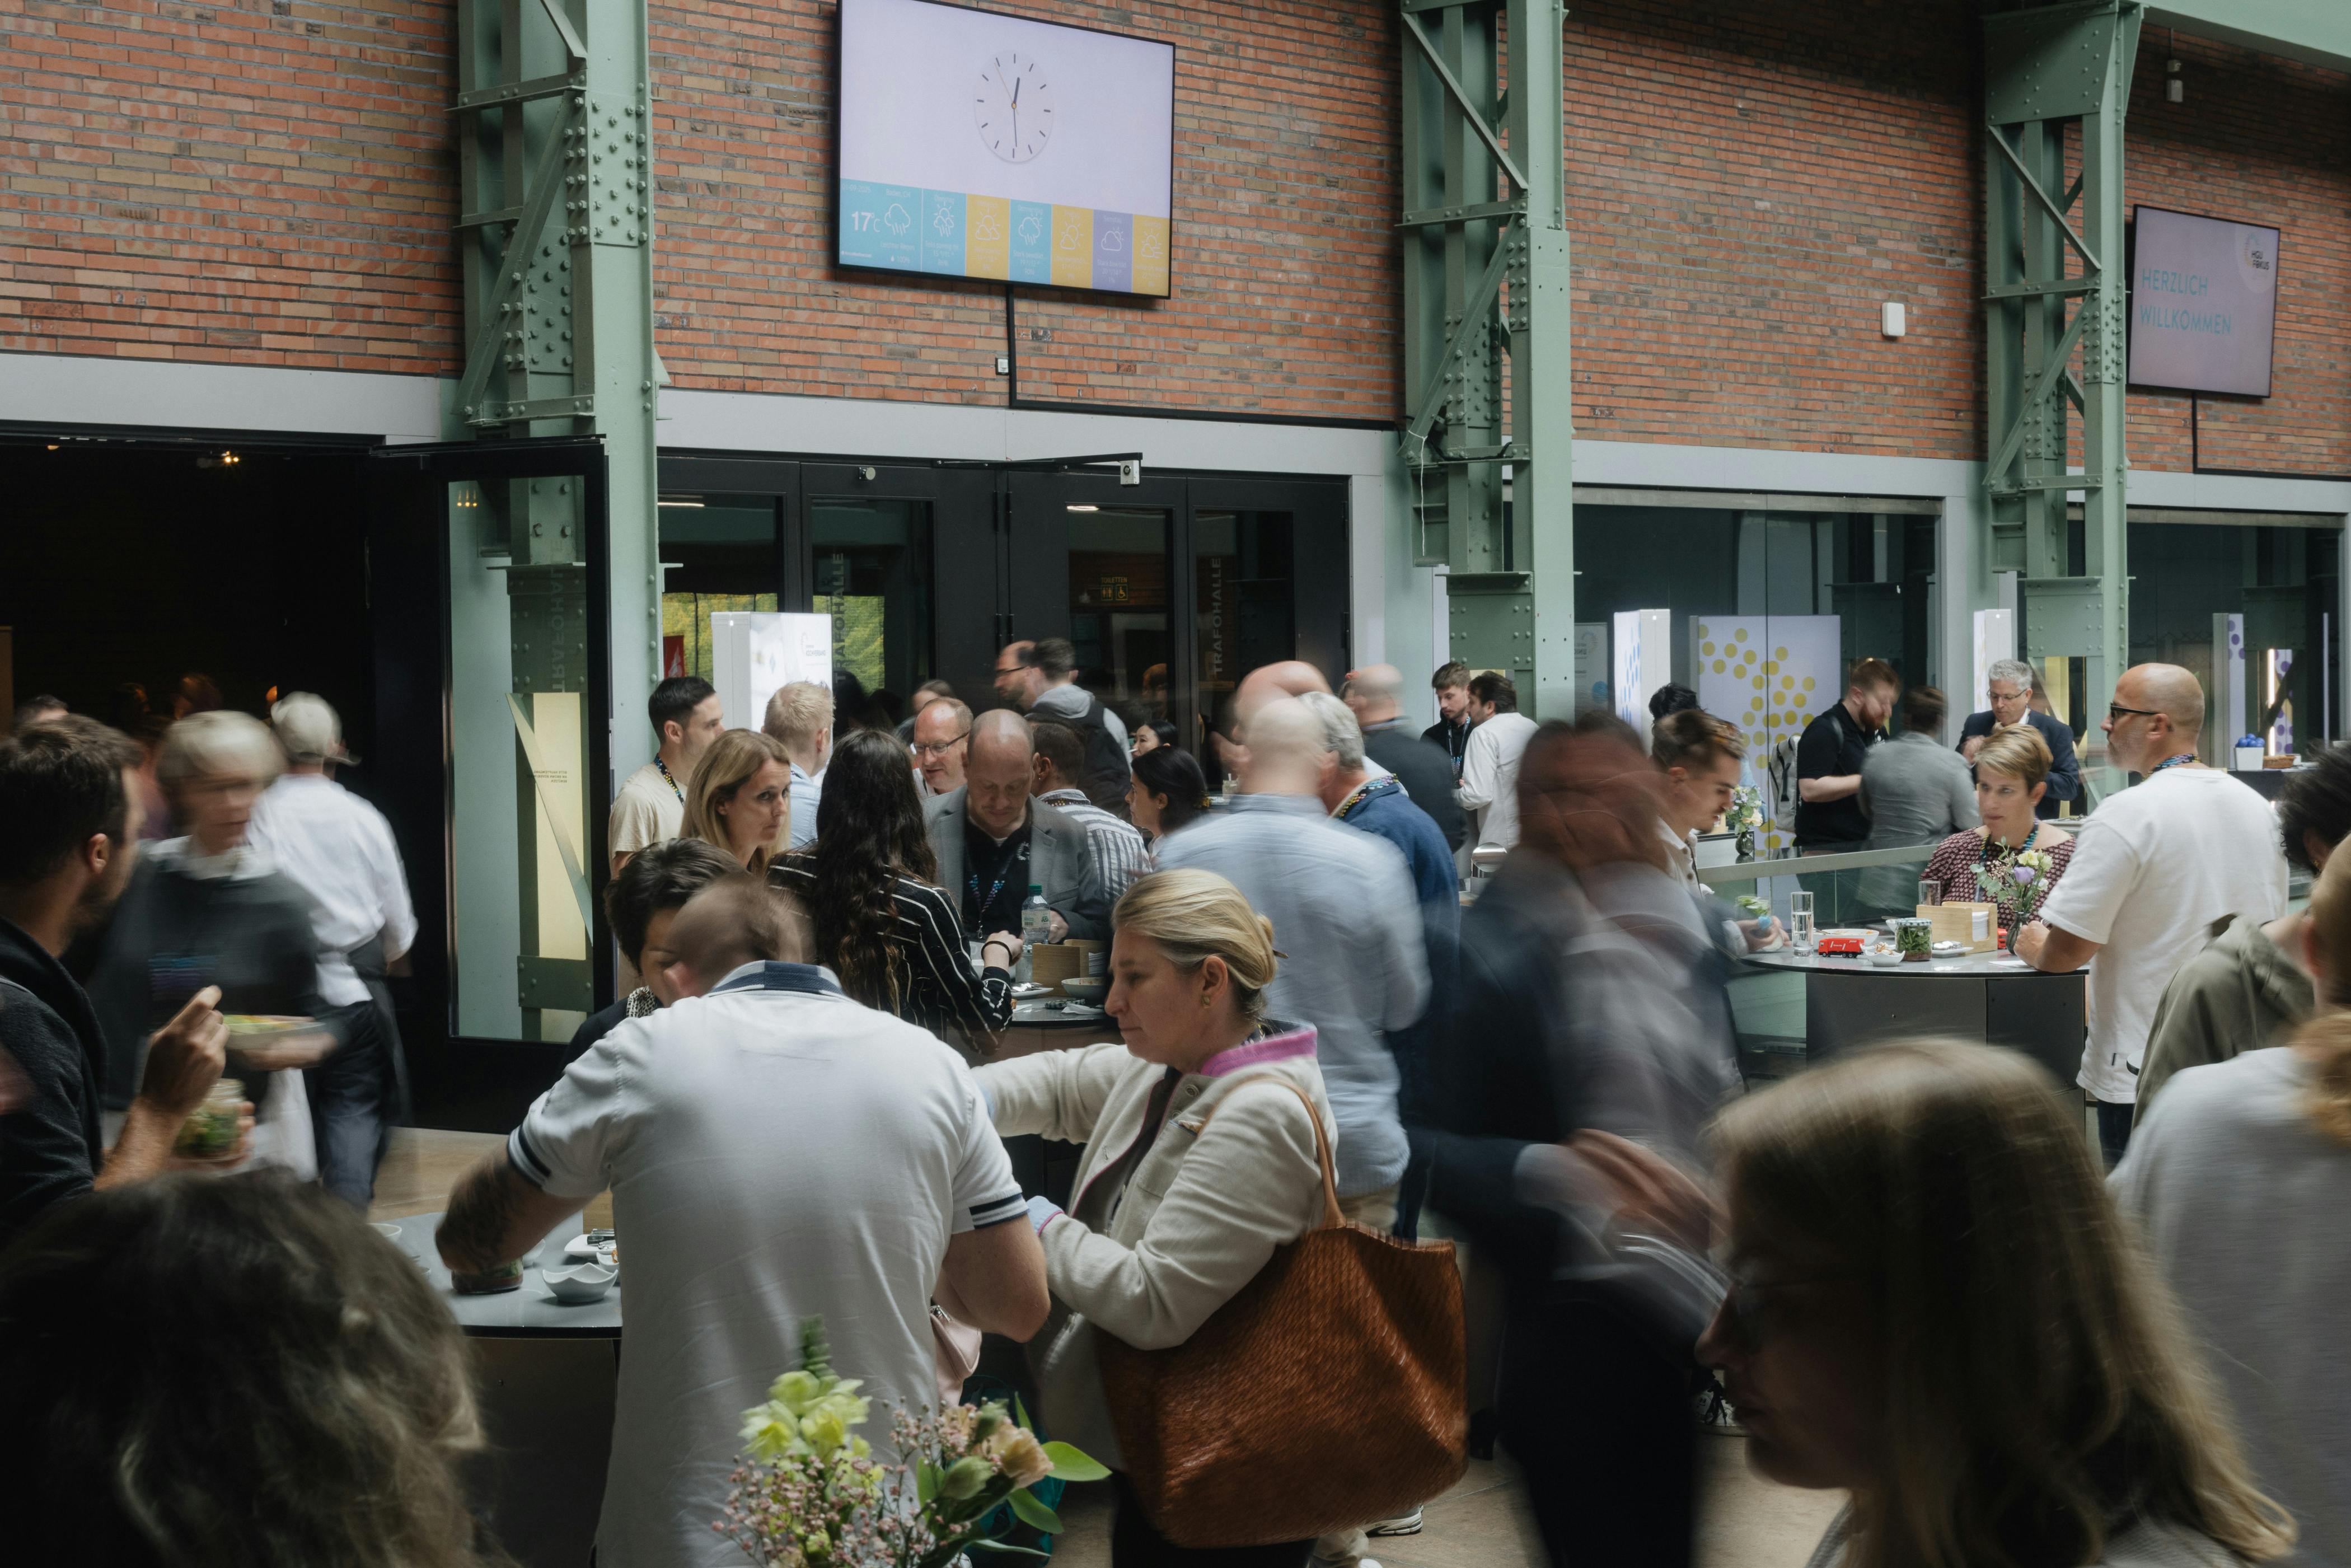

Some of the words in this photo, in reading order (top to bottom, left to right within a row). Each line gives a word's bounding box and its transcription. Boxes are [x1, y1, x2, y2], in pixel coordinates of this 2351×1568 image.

[2141, 268, 2208, 296] HERZLICH
[2139, 305, 2232, 335] WILLKOMMEN
[1211, 558, 1223, 673] TRAFOHALLE
